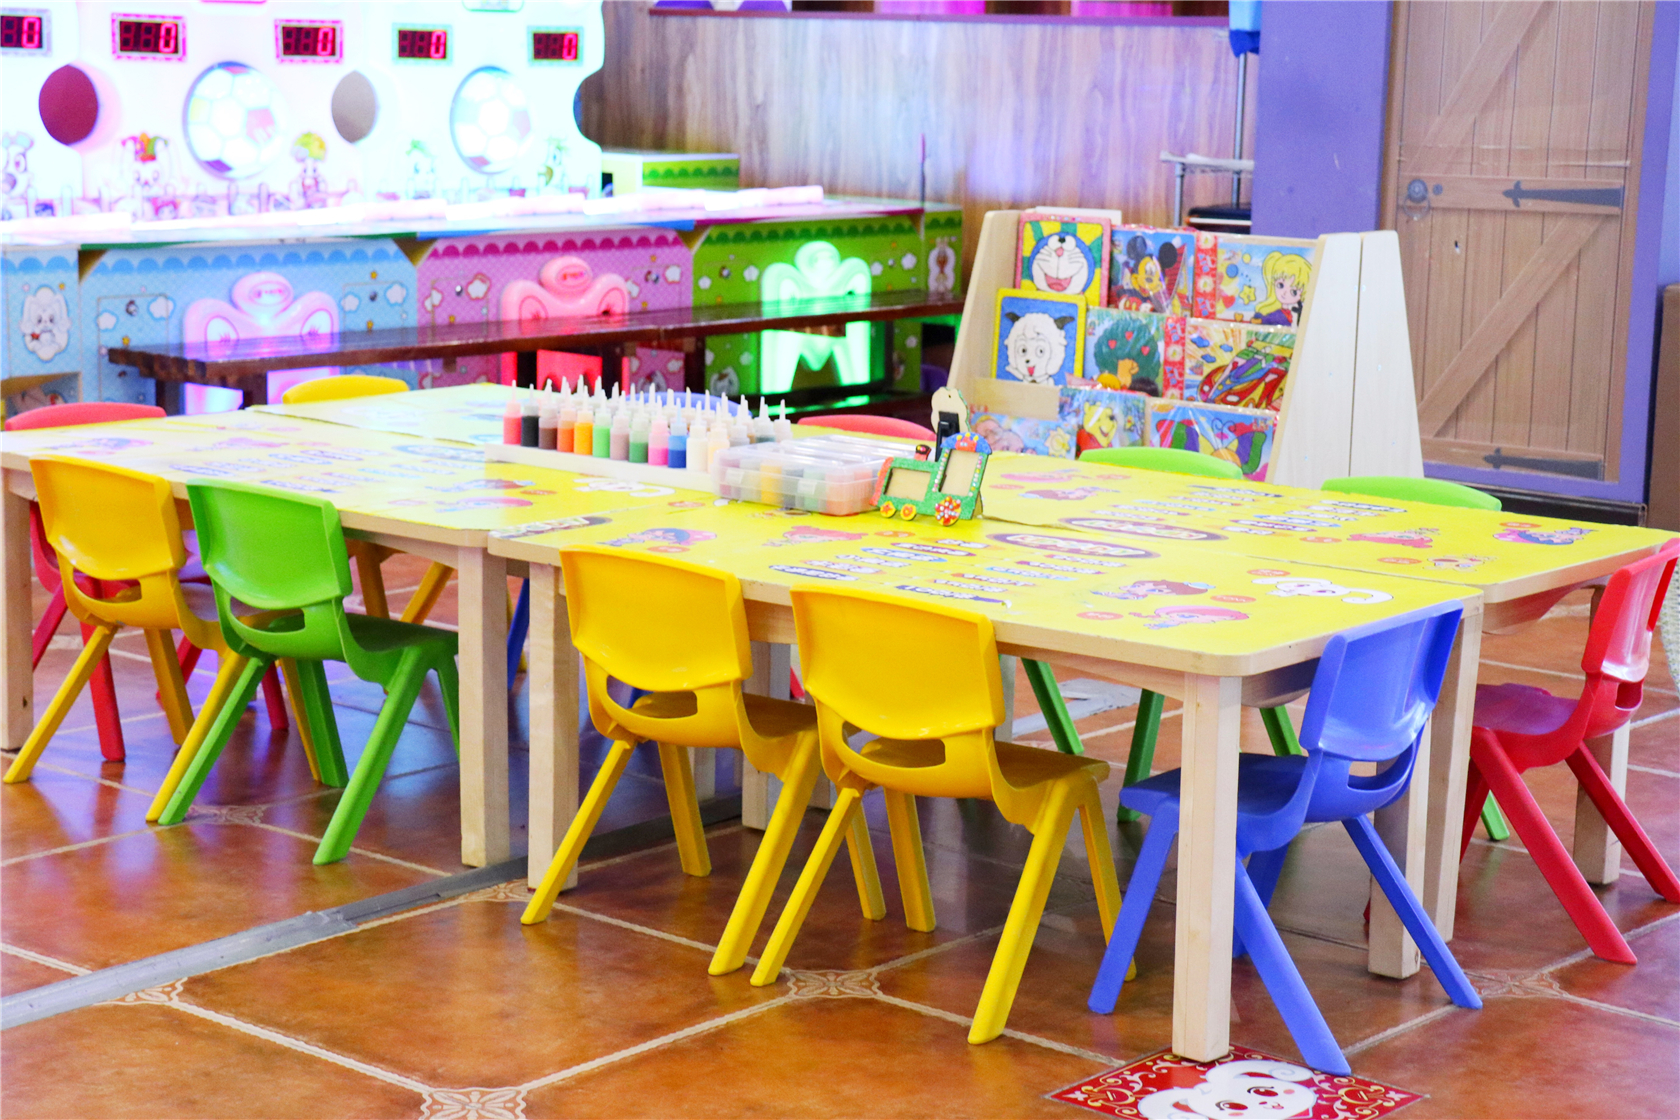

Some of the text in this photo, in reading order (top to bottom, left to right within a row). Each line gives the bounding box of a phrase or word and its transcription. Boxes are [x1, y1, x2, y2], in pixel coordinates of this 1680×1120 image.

[22, 15, 41, 49] 0
[158, 21, 178, 54] 0
[316, 26, 334, 57] 0
[429, 29, 447, 60] 0
[562, 32, 578, 61] 0
